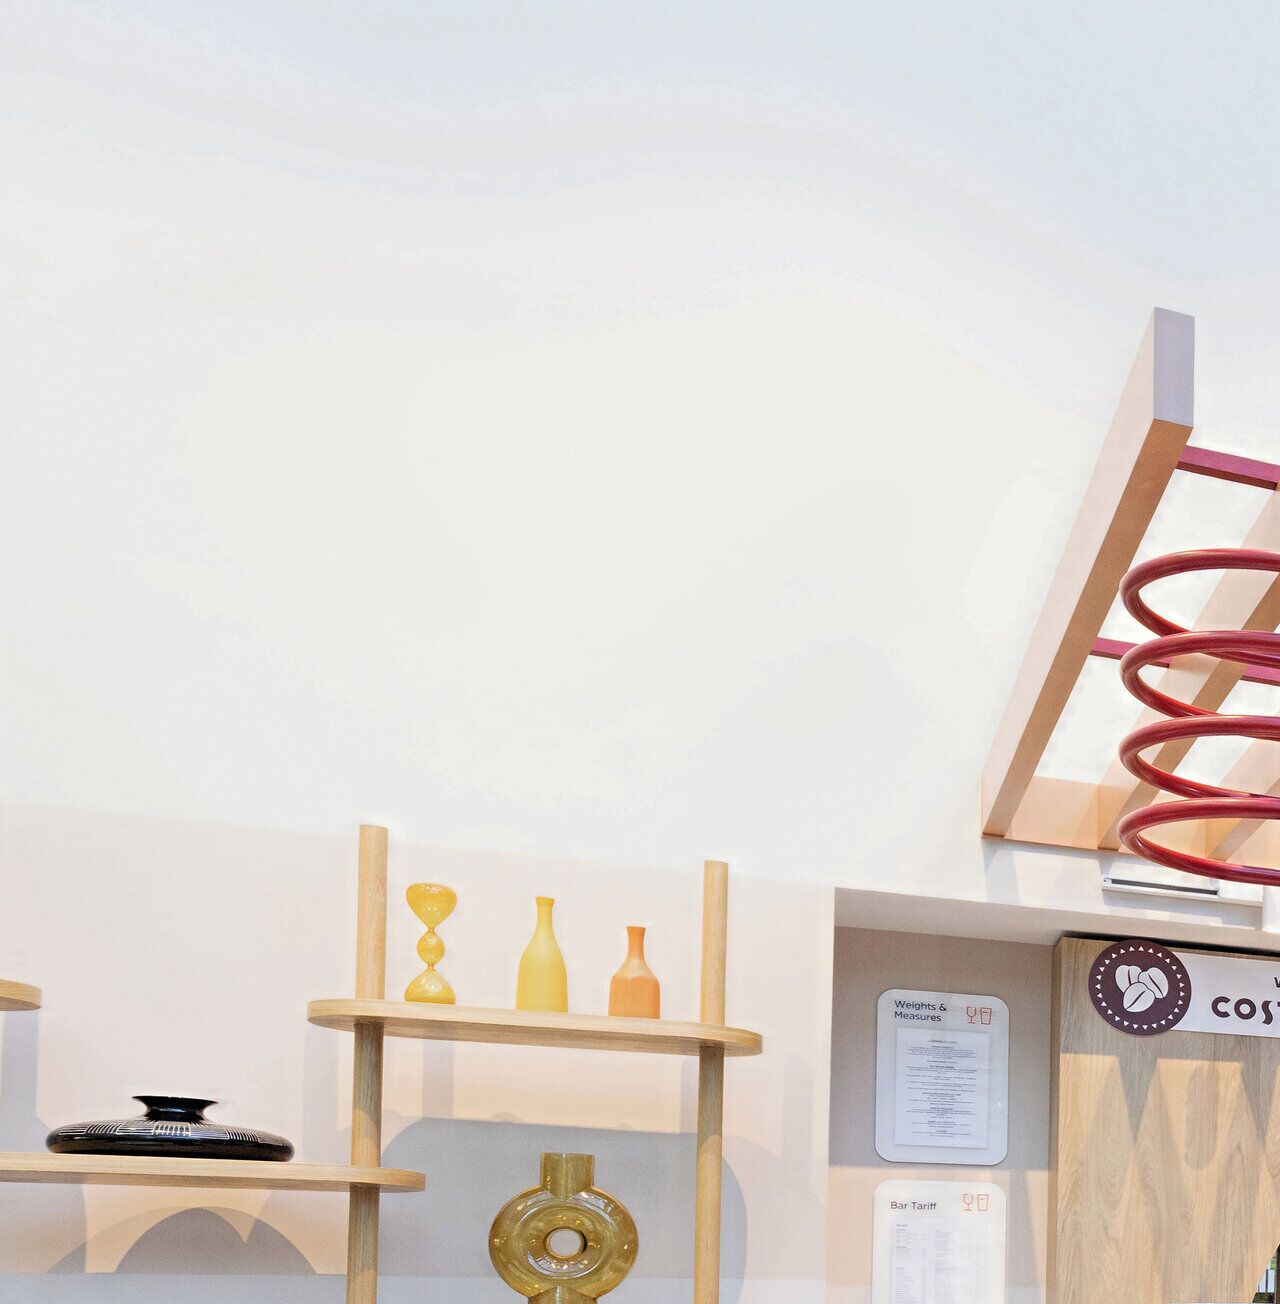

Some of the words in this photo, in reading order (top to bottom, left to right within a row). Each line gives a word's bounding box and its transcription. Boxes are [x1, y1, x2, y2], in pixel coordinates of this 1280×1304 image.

[894, 1000, 936, 1011] Weights
[939, 1003, 947, 1011] &
[894, 1011, 941, 1022] Measures
[890, 1201, 908, 1210] Bar
[911, 1201, 937, 1210] Tariff
